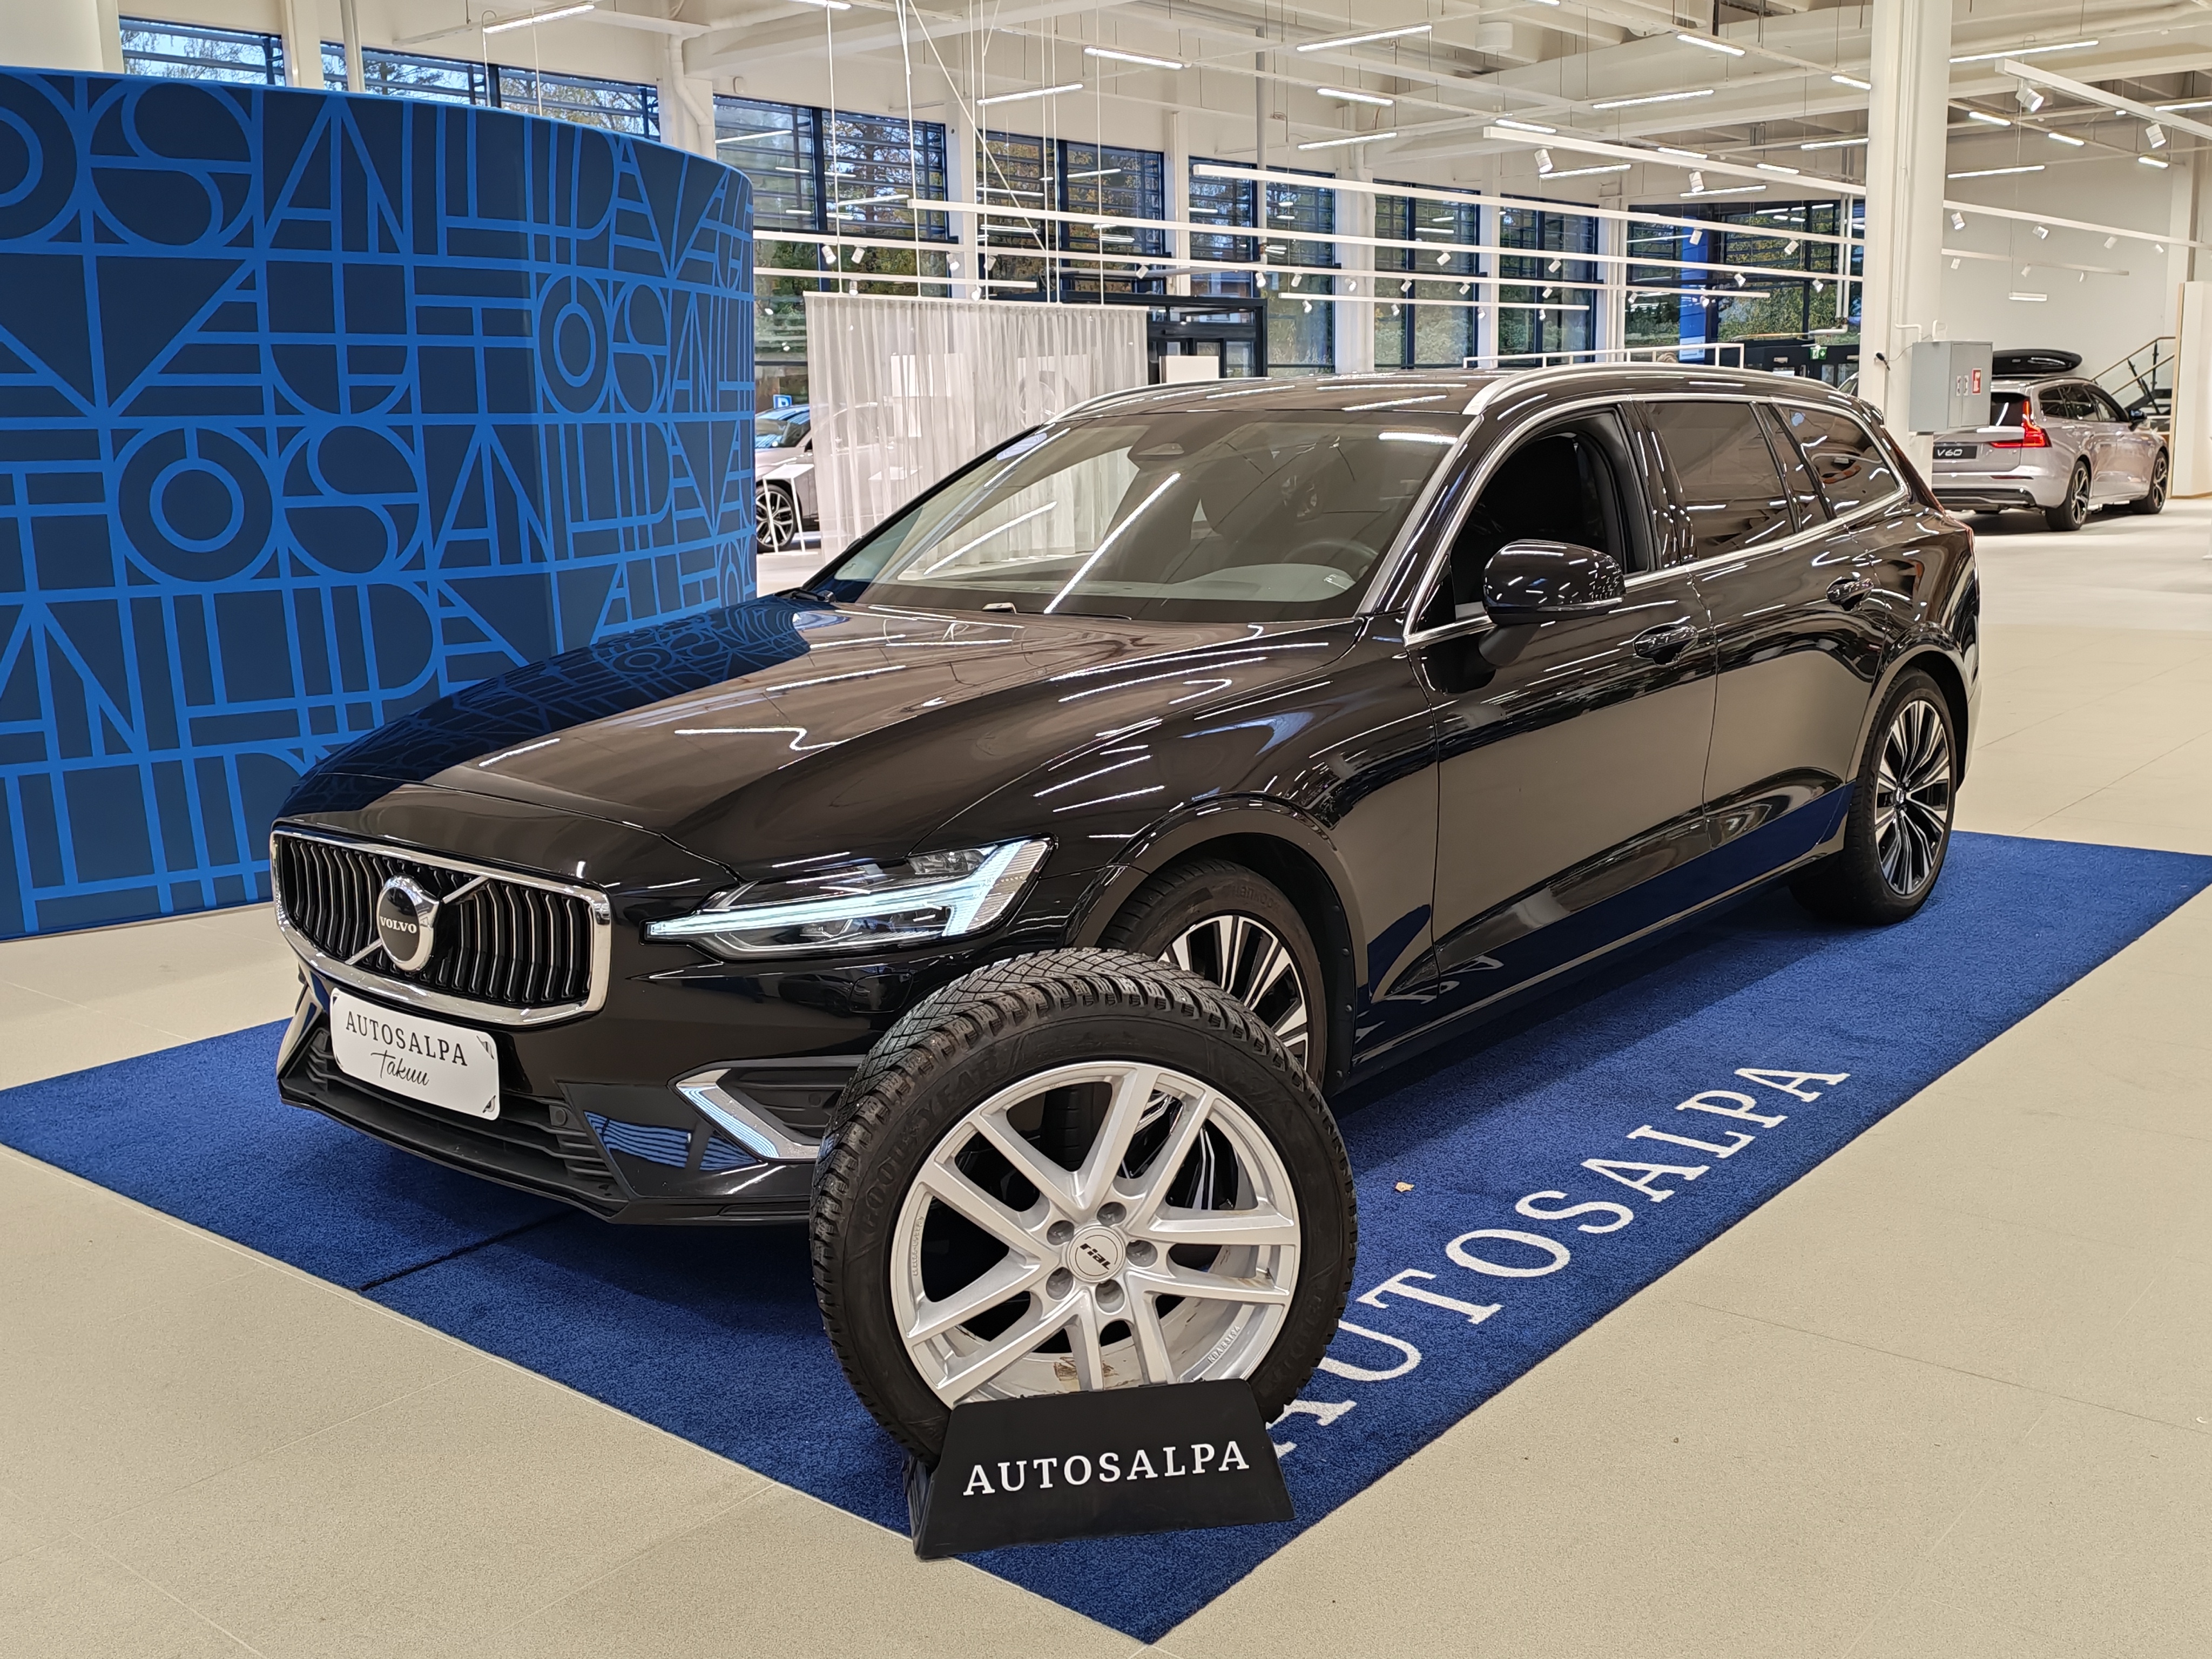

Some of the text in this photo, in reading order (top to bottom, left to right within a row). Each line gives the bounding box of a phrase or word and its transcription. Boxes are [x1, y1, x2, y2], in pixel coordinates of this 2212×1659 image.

[379, 915, 417, 934] VOLVO
[346, 1010, 468, 1067] AUTOSALPA
[962, 1440, 1250, 1496] AUTOSALPA
